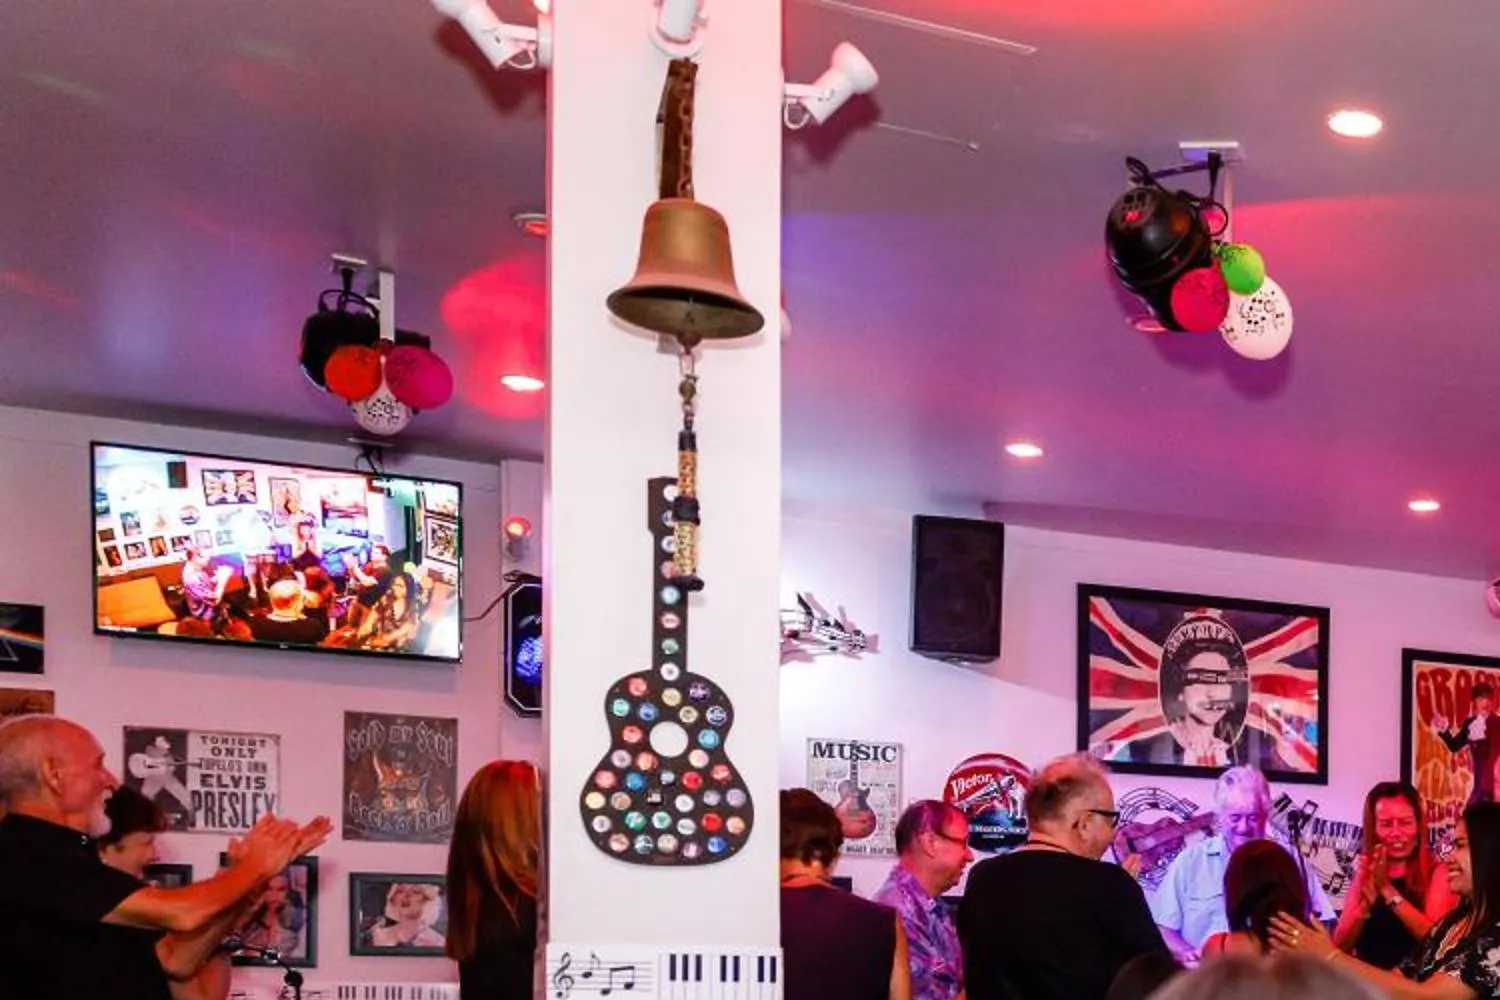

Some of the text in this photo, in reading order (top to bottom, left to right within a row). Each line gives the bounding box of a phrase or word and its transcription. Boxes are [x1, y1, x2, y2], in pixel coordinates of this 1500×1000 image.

[200, 735, 267, 748] TONIGHT
[211, 745, 258, 759] ONLY
[812, 741, 897, 763] MUSIC
[200, 773, 268, 790] ELVIS
[189, 789, 276, 829] PRESLEY
